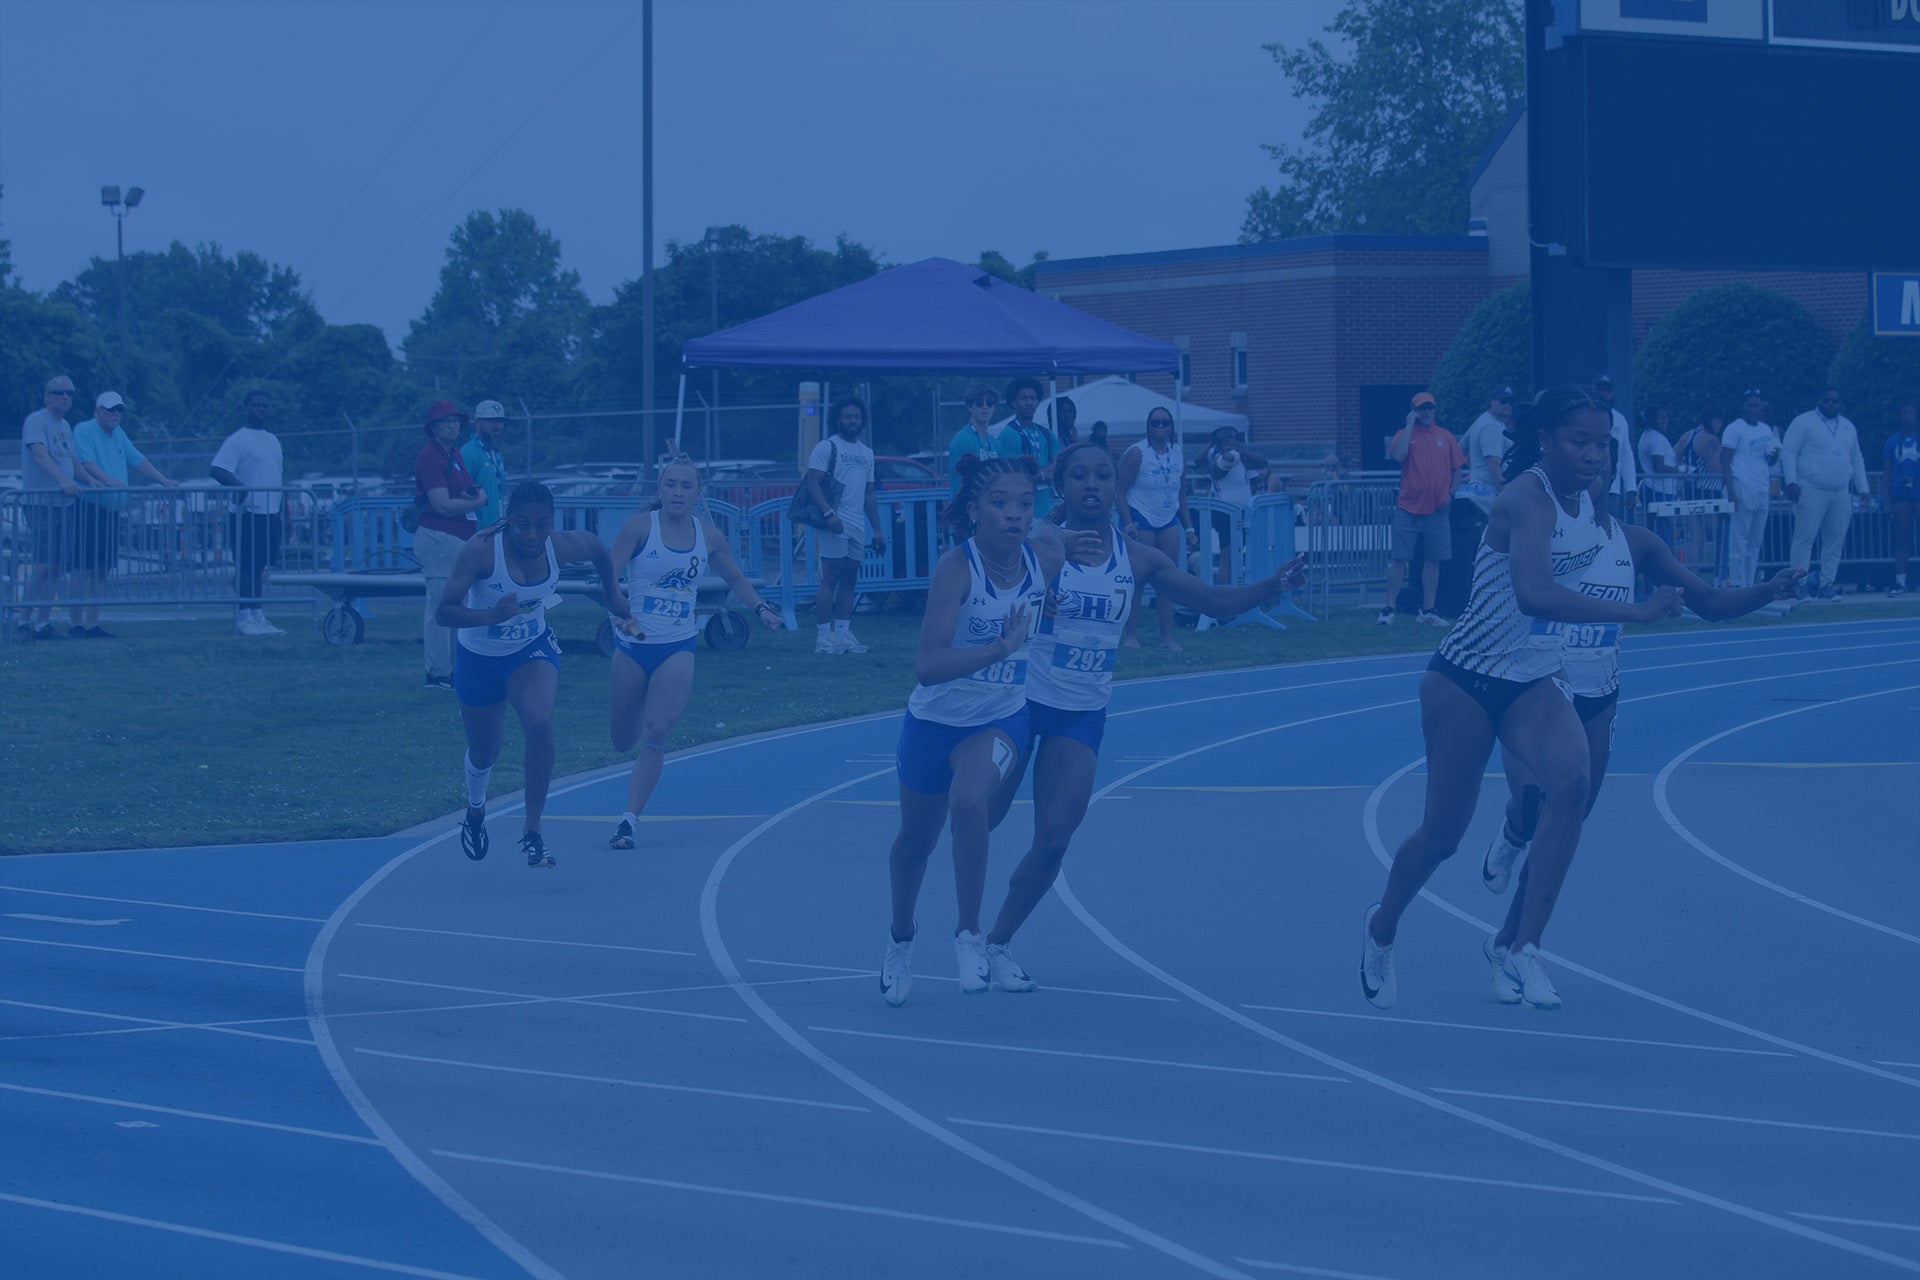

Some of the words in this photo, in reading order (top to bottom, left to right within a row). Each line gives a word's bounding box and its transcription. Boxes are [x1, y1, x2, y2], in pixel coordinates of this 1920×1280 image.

[687, 556, 699, 579] 8
[1114, 575, 1133, 584] CAA
[652, 598, 682, 617] 229
[1115, 589, 1127, 620] 7
[1031, 599, 1042, 635] 7
[1566, 623, 1606, 647] 697
[1066, 647, 1107, 671] 292
